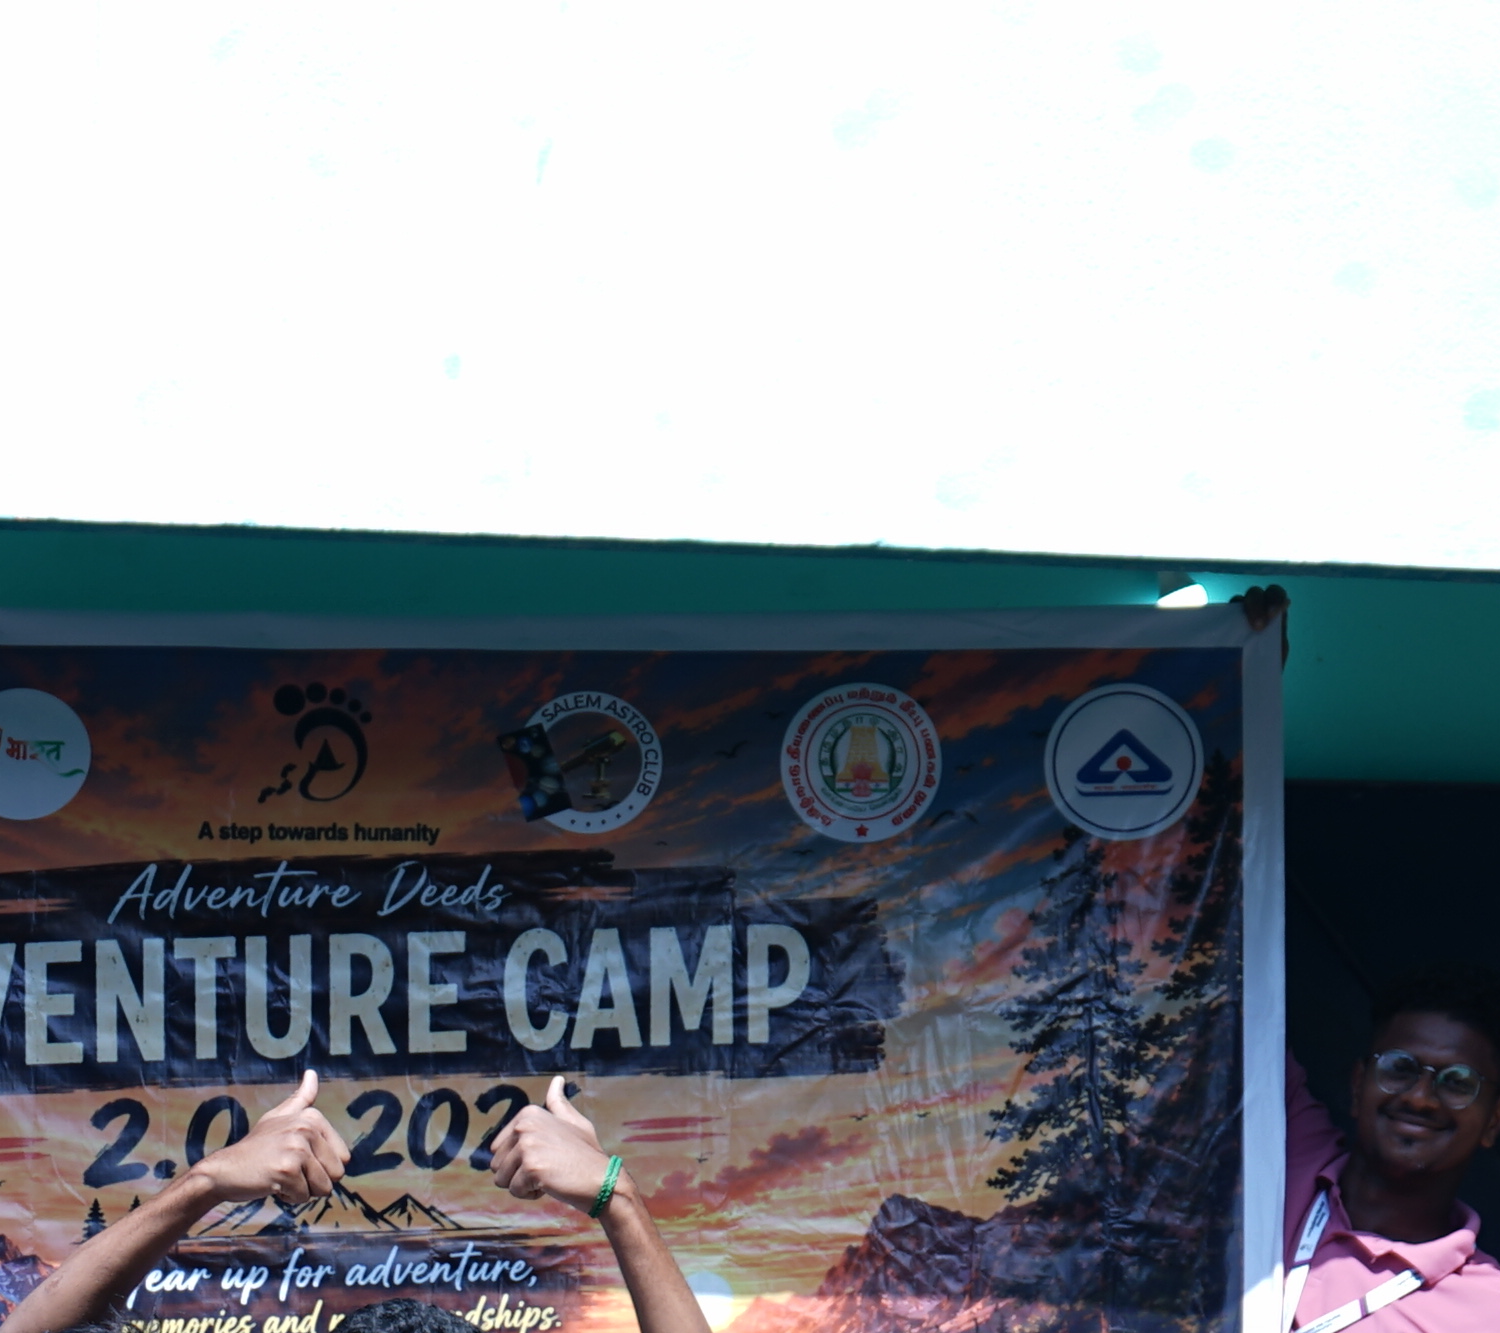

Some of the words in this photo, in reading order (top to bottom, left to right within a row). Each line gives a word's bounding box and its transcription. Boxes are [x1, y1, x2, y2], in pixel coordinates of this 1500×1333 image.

[541, 694, 602, 723] SALEM
[604, 700, 655, 747] ASTRO
[636, 748, 660, 798] CLUB
[198, 821, 213, 840] A
[219, 823, 262, 843] step
[268, 822, 349, 841] towards
[107, 859, 362, 925] Adventure
[377, 857, 511, 919] Deeds
[502, 922, 811, 1054] CAMP
[126, 1263, 211, 1310] ear
[221, 1263, 268, 1306] up
[279, 1246, 336, 1302] for
[344, 1241, 538, 1288] adventure,
